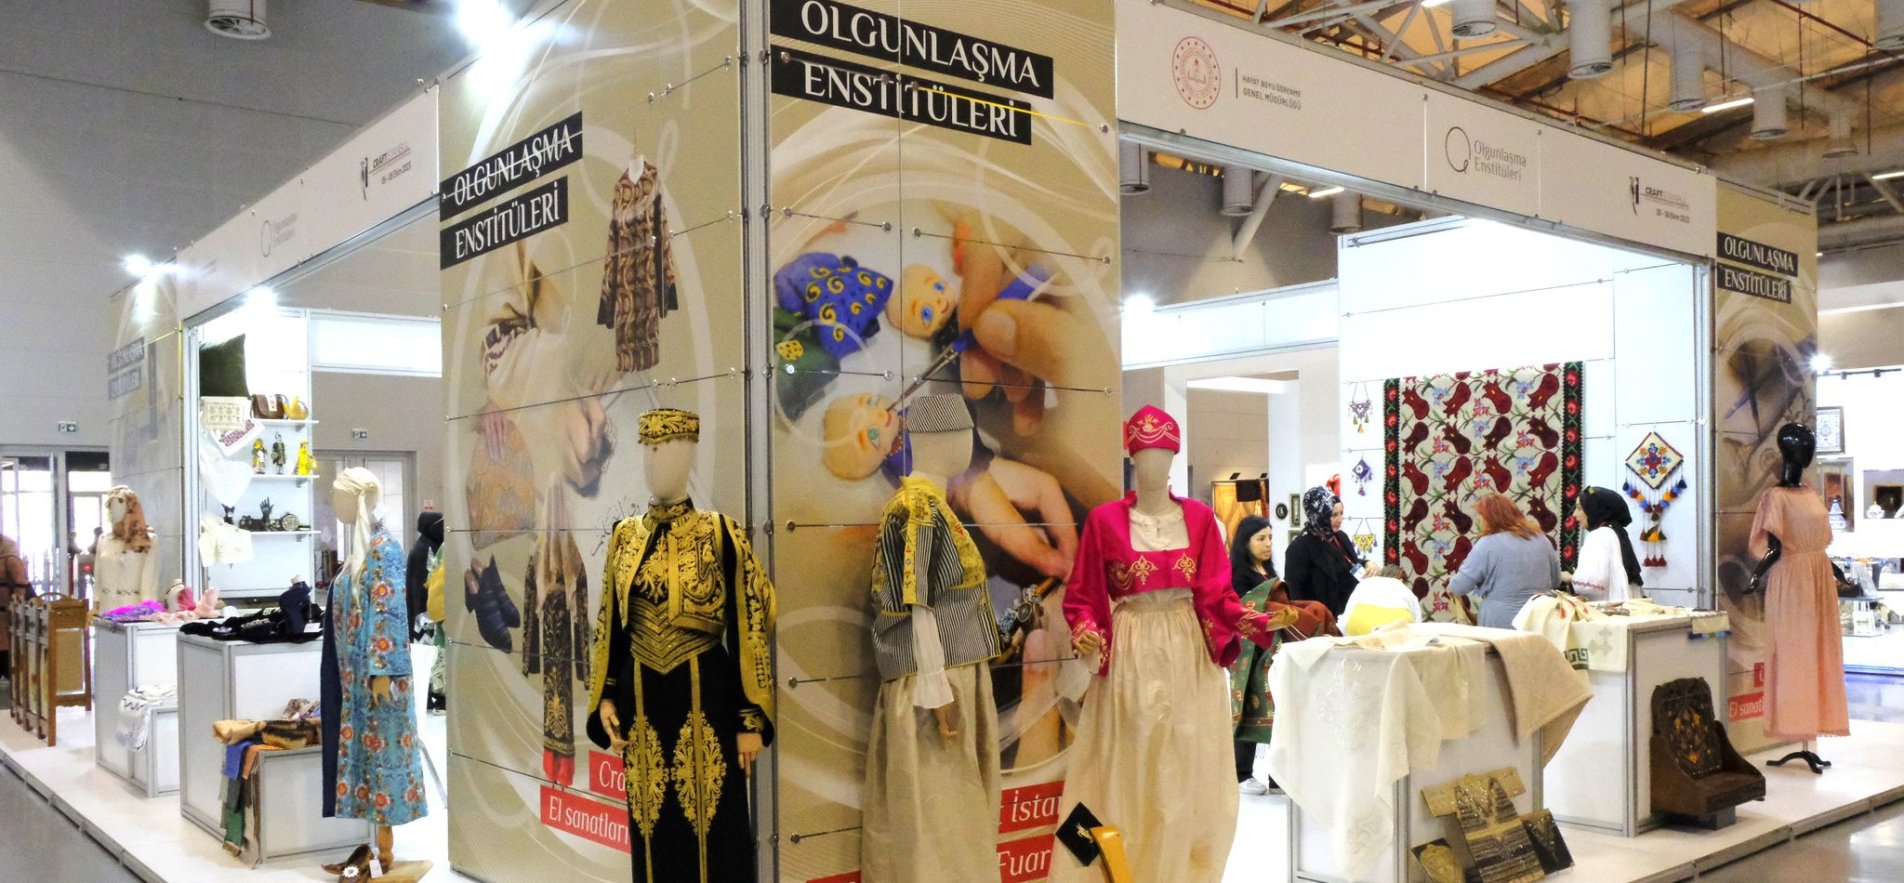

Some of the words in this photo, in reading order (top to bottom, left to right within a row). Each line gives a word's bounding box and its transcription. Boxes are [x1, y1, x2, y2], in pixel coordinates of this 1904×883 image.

[801, 0, 1040, 87] OLGUNLAŞMA
[804, 61, 1017, 137] ENSTİTÜLERİ
[454, 124, 573, 206] OLGUNLAŞMA
[455, 181, 559, 259] ENSTİTÜLERİ
[1724, 236, 1794, 272] OLGUNLAŞMA
[1724, 269, 1787, 300] ENSTİTÜLERİ
[549, 795, 562, 822] El
